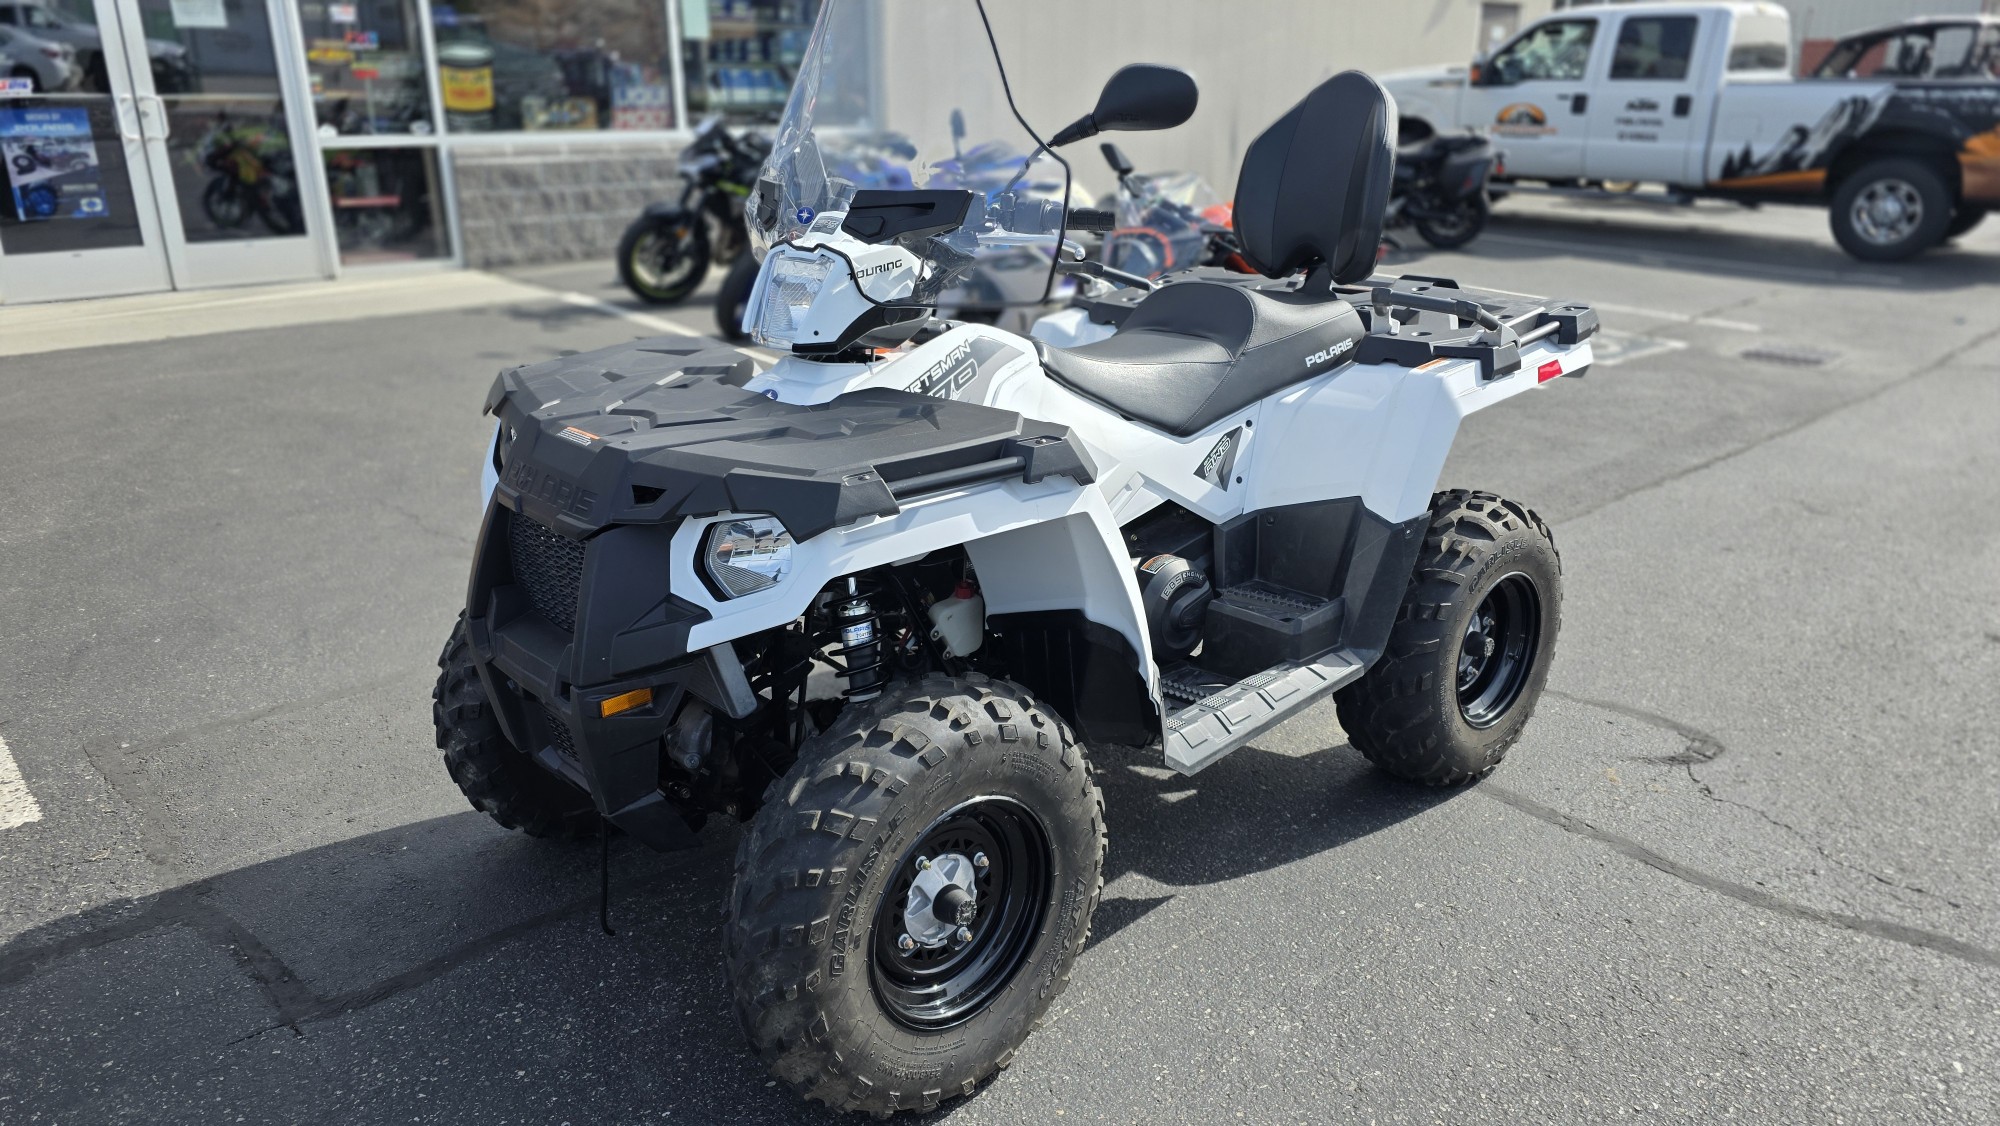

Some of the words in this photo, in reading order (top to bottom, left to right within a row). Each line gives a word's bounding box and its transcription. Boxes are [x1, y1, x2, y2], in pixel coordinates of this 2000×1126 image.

[847, 259, 903, 281] TOURING
[903, 339, 971, 394] RTSMAN
[1305, 337, 1354, 368] POLARIS
[507, 459, 598, 519] POLARIS
